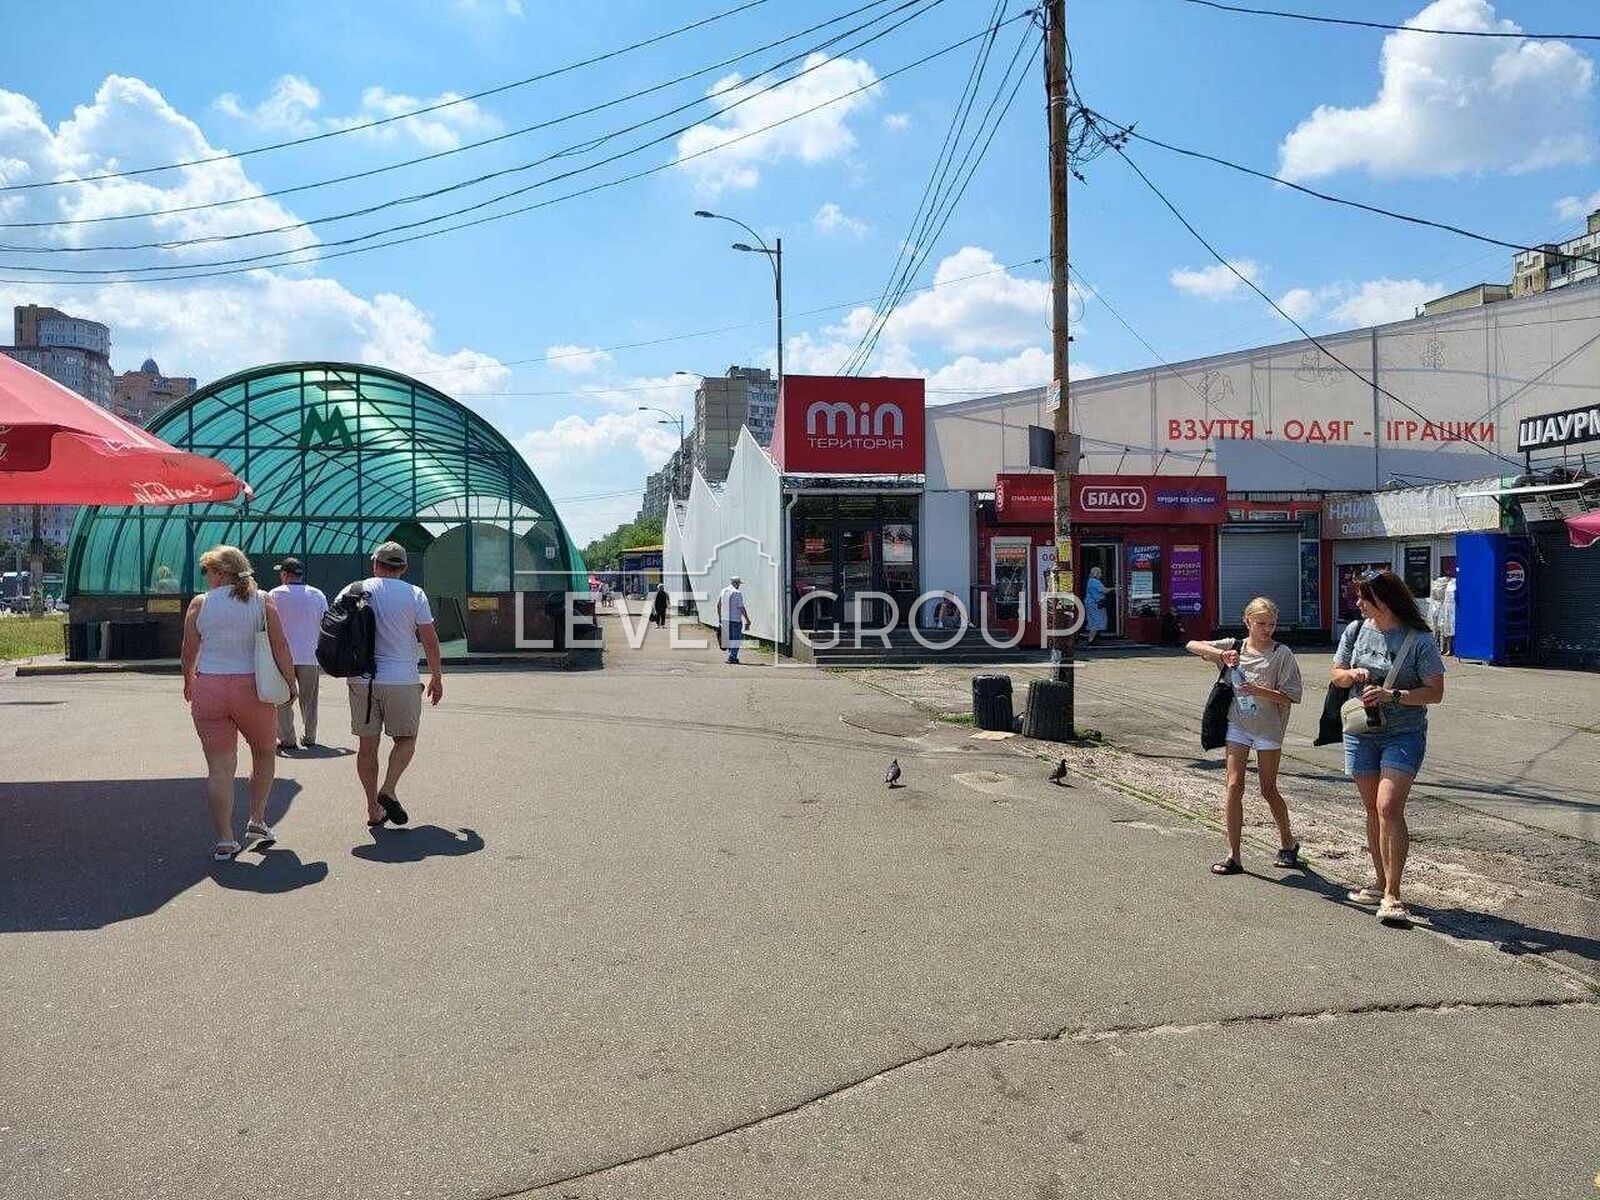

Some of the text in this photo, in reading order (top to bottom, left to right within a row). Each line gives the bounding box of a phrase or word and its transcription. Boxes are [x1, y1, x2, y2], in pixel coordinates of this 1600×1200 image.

[806, 401, 904, 436] min
[1168, 419, 1254, 441] ВЗУТТЯ
[1283, 419, 1354, 443] ОДЯГ
[1386, 421, 1497, 442] ІГРАШКИ
[807, 437, 904, 450] ТЕРИТОРІЯ
[1087, 491, 1141, 507] БЛАГО
